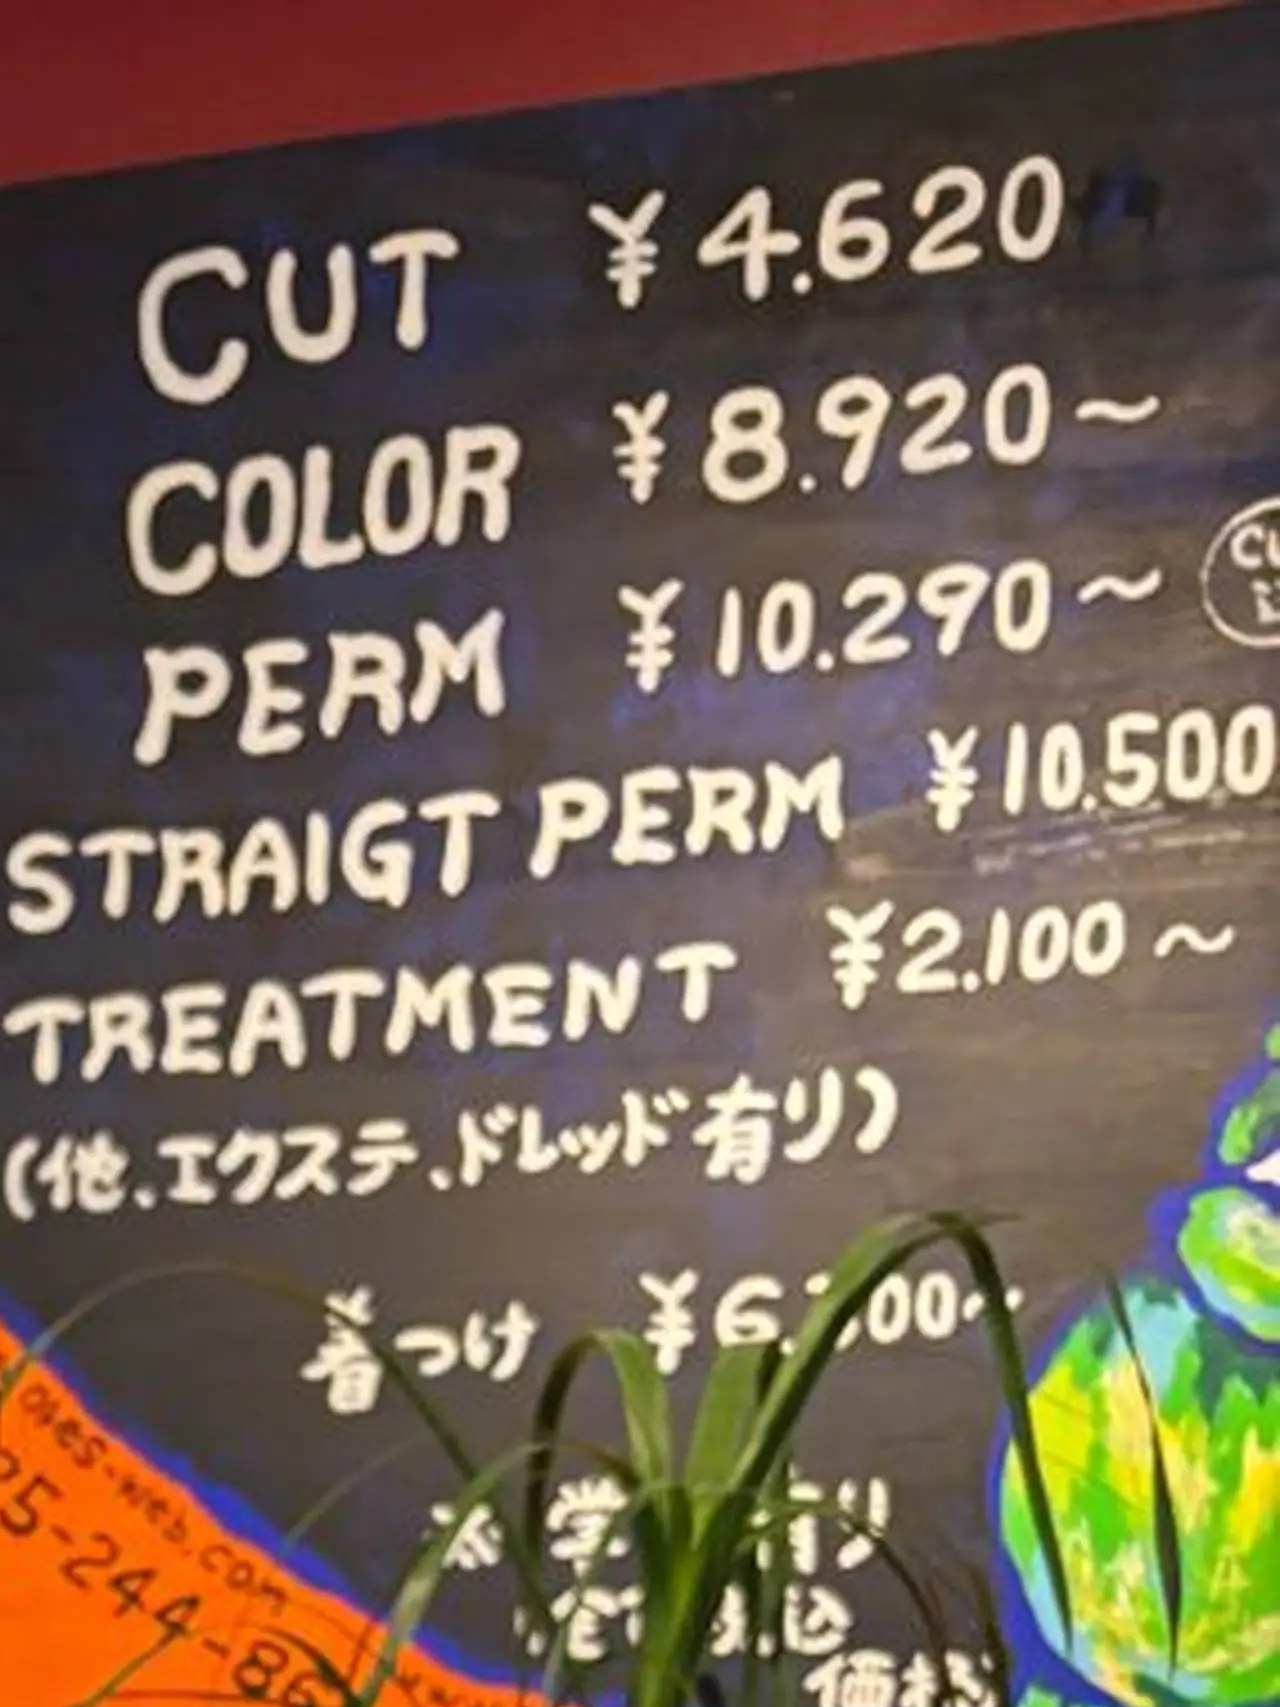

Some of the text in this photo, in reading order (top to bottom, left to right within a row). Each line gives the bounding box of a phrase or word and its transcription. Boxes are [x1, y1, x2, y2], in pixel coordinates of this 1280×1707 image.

[141, 230, 458, 403] CUT
[130, 427, 520, 595] COLOR
[135, 610, 505, 764] PERM
[6, 790, 501, 933] STRAIGT
[529, 755, 845, 881] PERM
[3, 942, 738, 1083] TREATMENT
